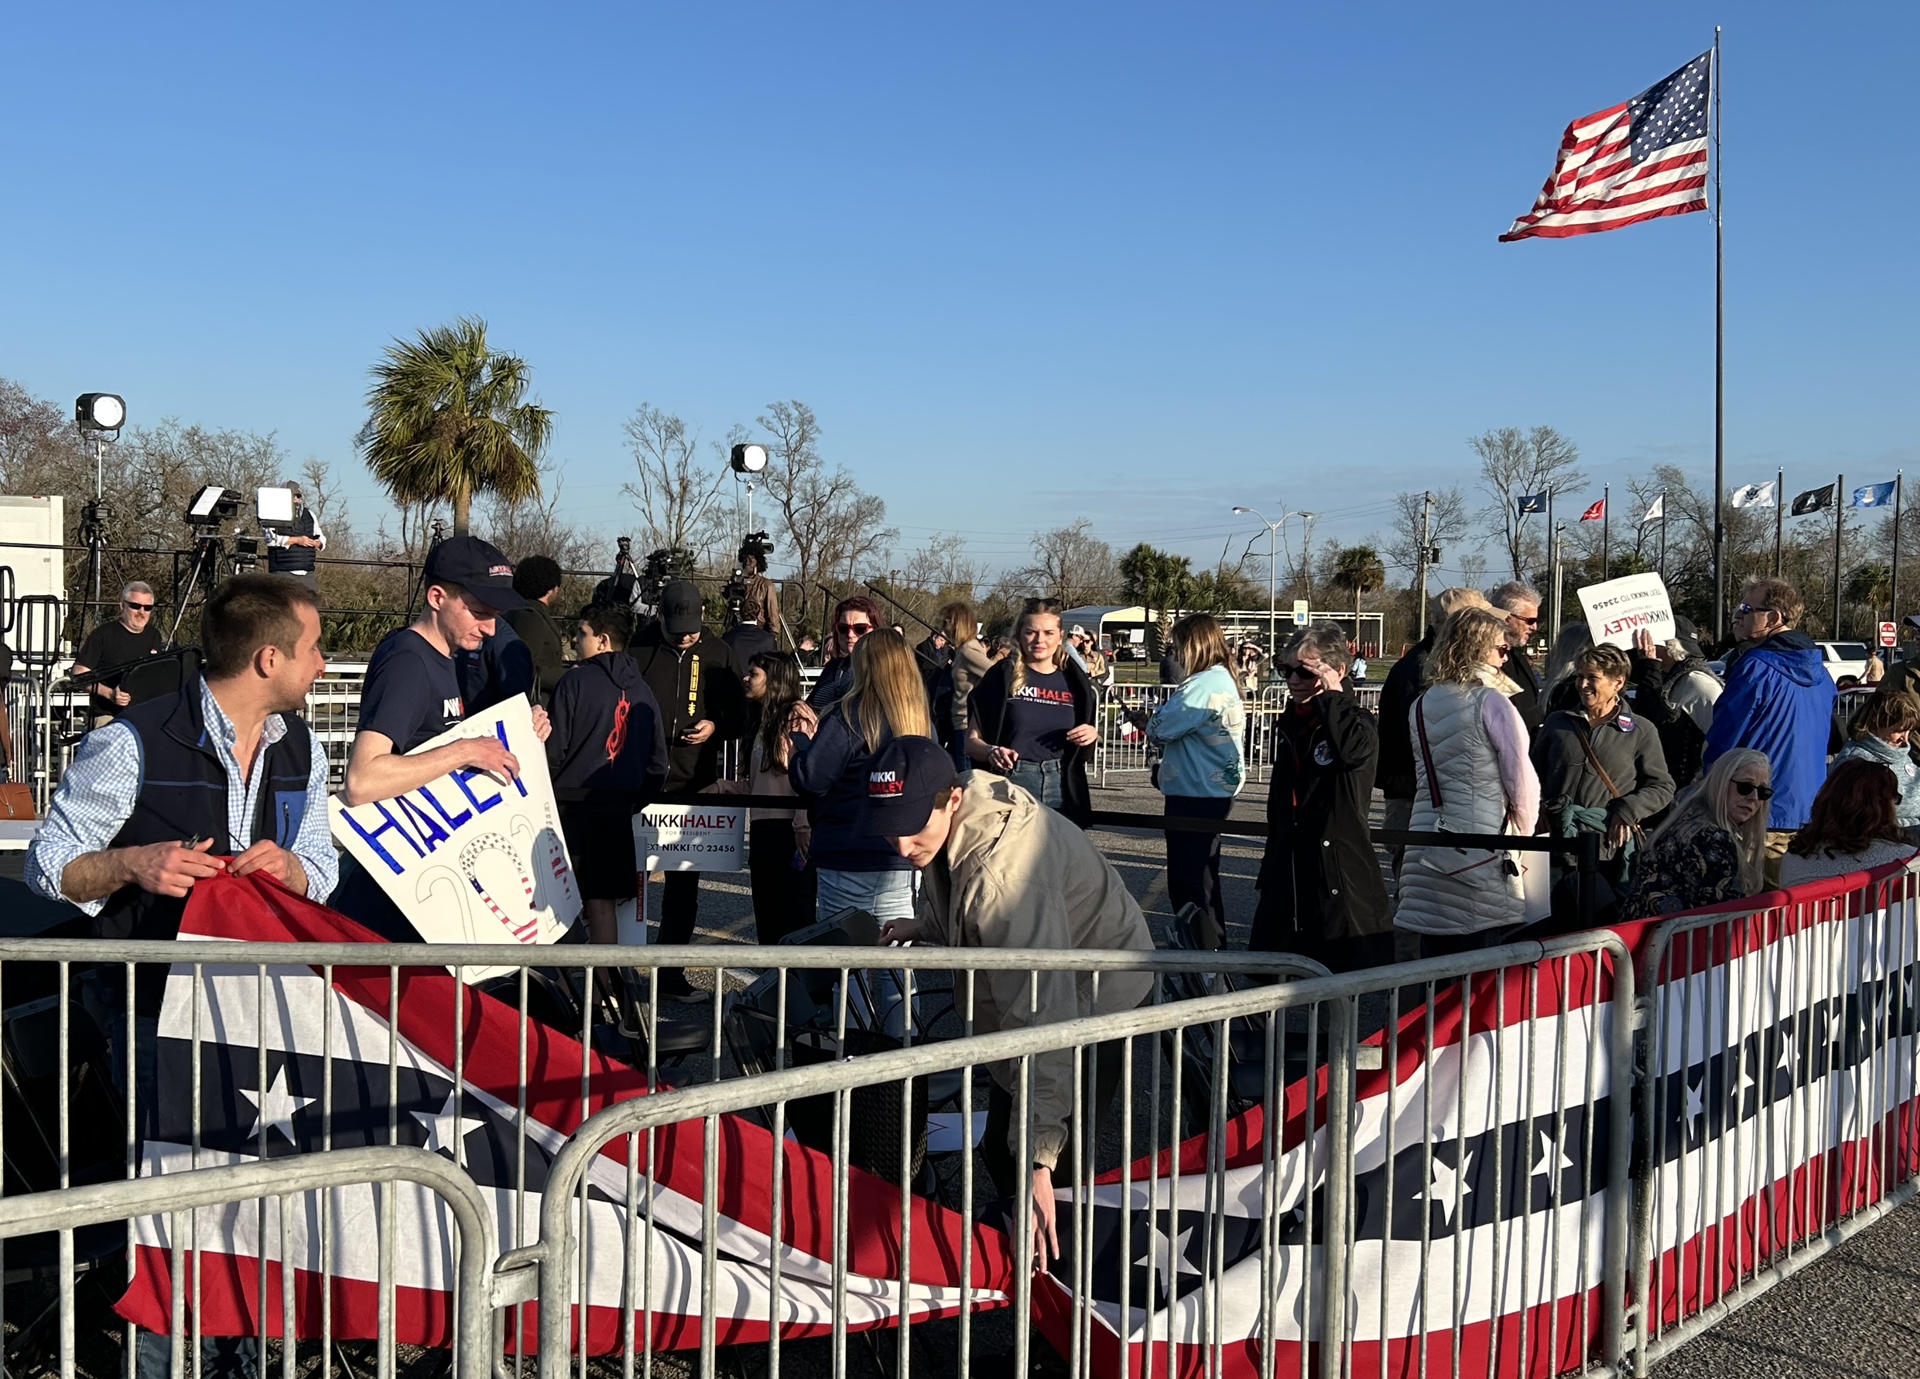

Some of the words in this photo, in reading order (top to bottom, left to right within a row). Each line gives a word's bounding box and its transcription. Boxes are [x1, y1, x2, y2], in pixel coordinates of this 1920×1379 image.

[1592, 597, 1619, 611] 23456
[870, 771, 895, 782] NIKKI
[662, 844, 690, 852] NIKKI
[706, 845, 735, 853] 23456
